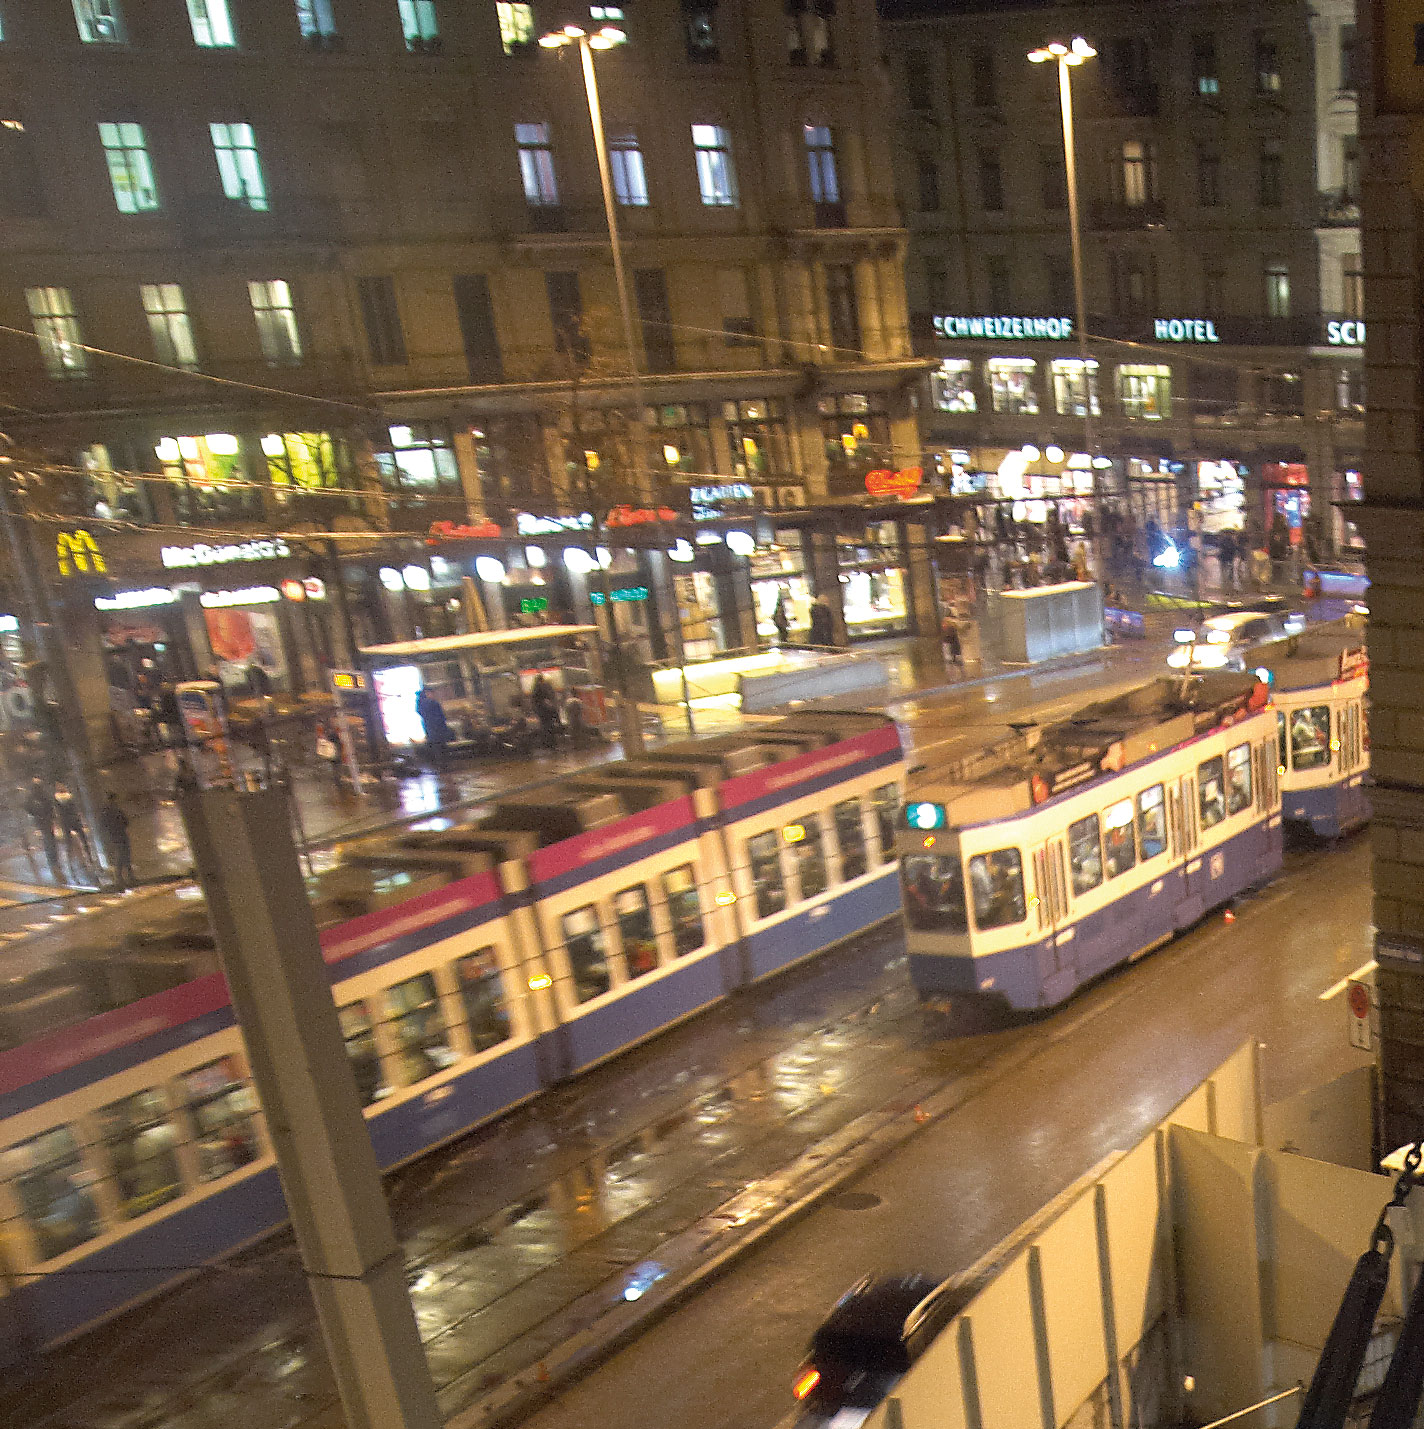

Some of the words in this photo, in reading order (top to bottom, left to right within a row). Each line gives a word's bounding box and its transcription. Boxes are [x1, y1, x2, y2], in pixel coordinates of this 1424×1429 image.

[933, 315, 1073, 340] SCHWEIZERHOF
[1154, 318, 1220, 344] HOTEL
[161, 538, 291, 569] McDonald's
